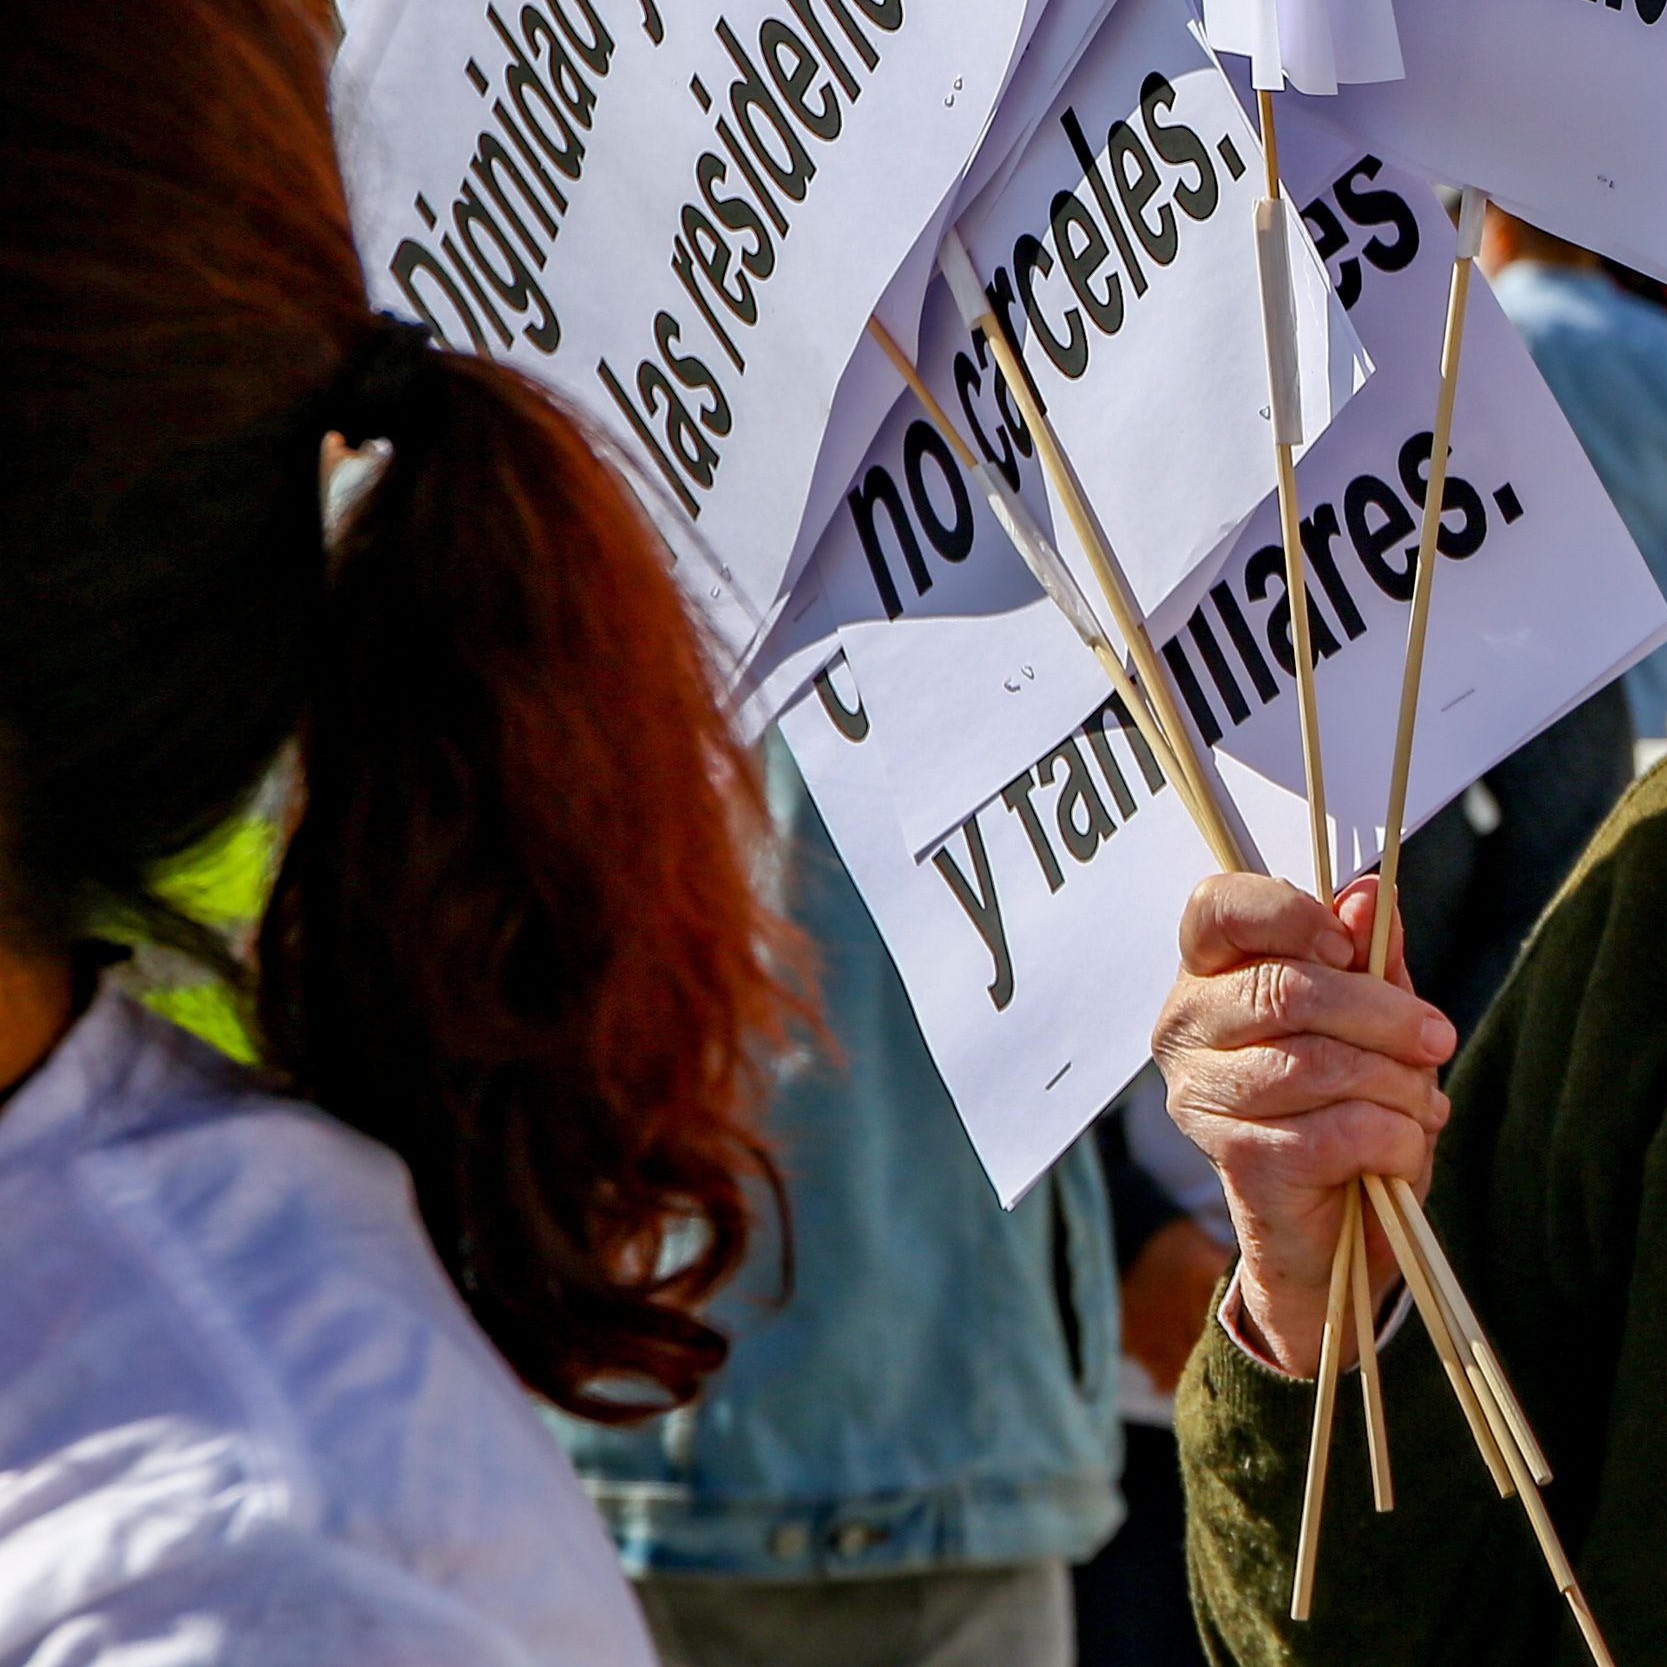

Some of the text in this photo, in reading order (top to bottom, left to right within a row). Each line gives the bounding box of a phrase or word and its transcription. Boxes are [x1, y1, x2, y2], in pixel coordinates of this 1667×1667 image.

[596, 310, 733, 522] las
[847, 418, 975, 622] no
[932, 815, 1014, 1012] y
